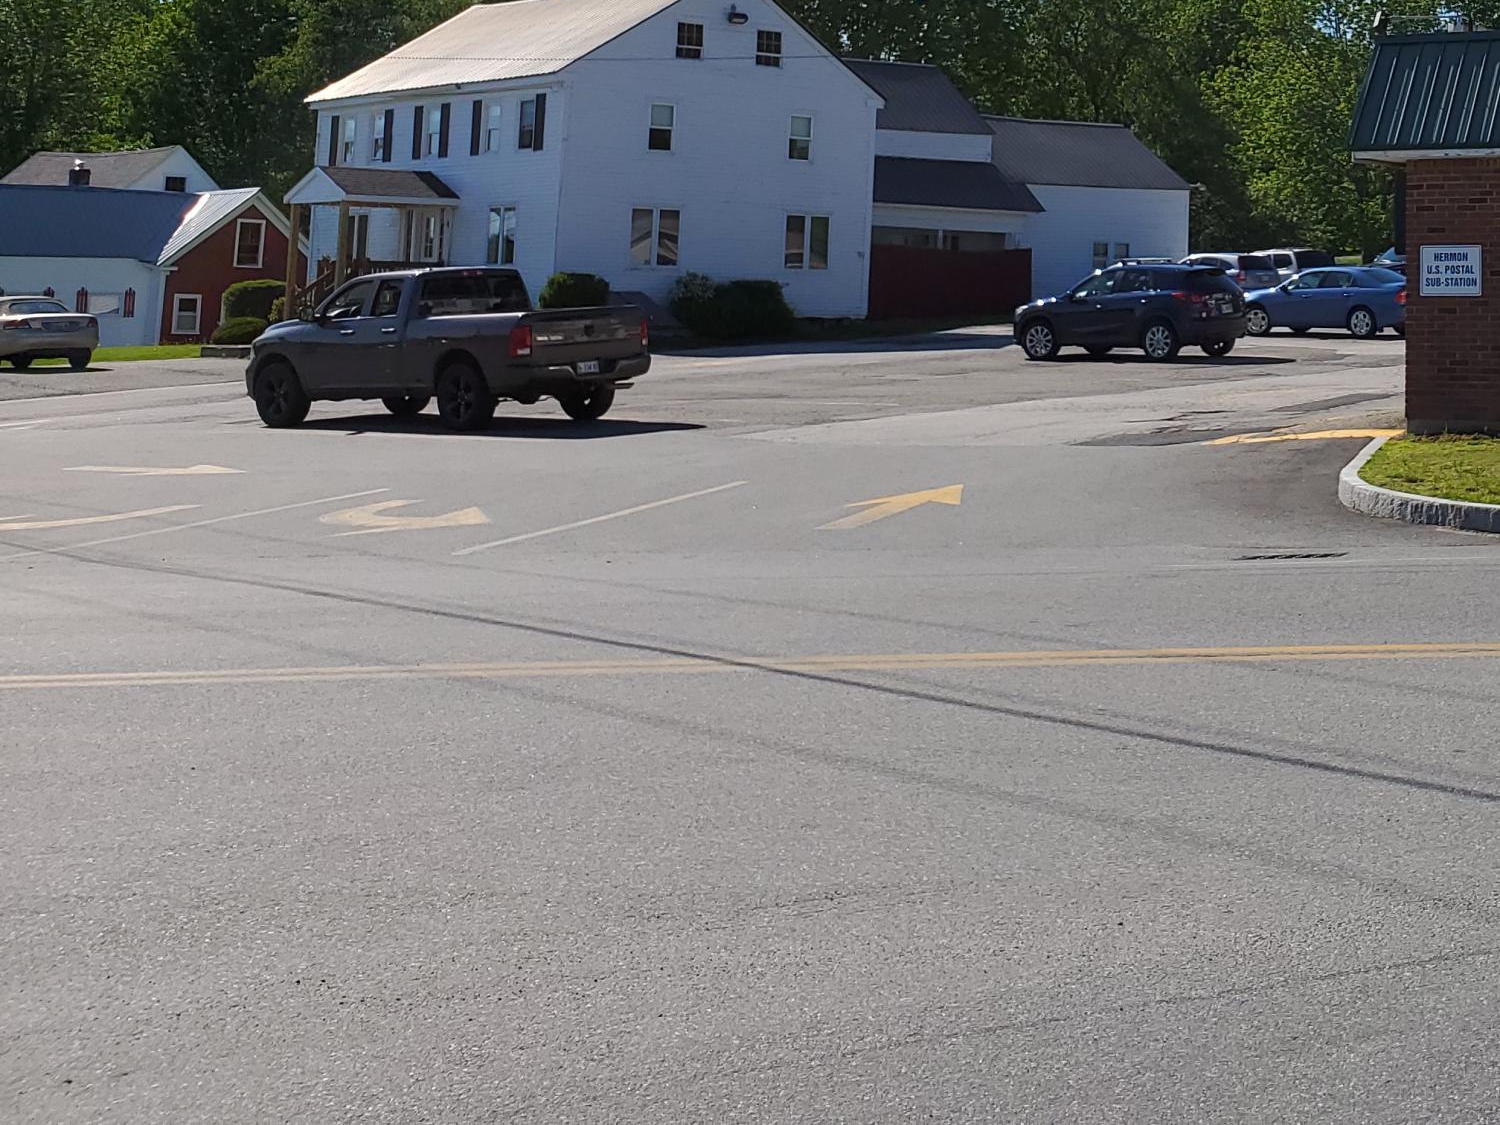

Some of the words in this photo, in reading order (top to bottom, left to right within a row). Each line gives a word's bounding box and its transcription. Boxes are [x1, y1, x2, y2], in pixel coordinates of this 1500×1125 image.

[1433, 252, 1468, 262] HERMON
[1426, 265, 1443, 275] U.S.
[1444, 265, 1475, 275] POSTAL
[1425, 277, 1477, 287] SUB-STATION
